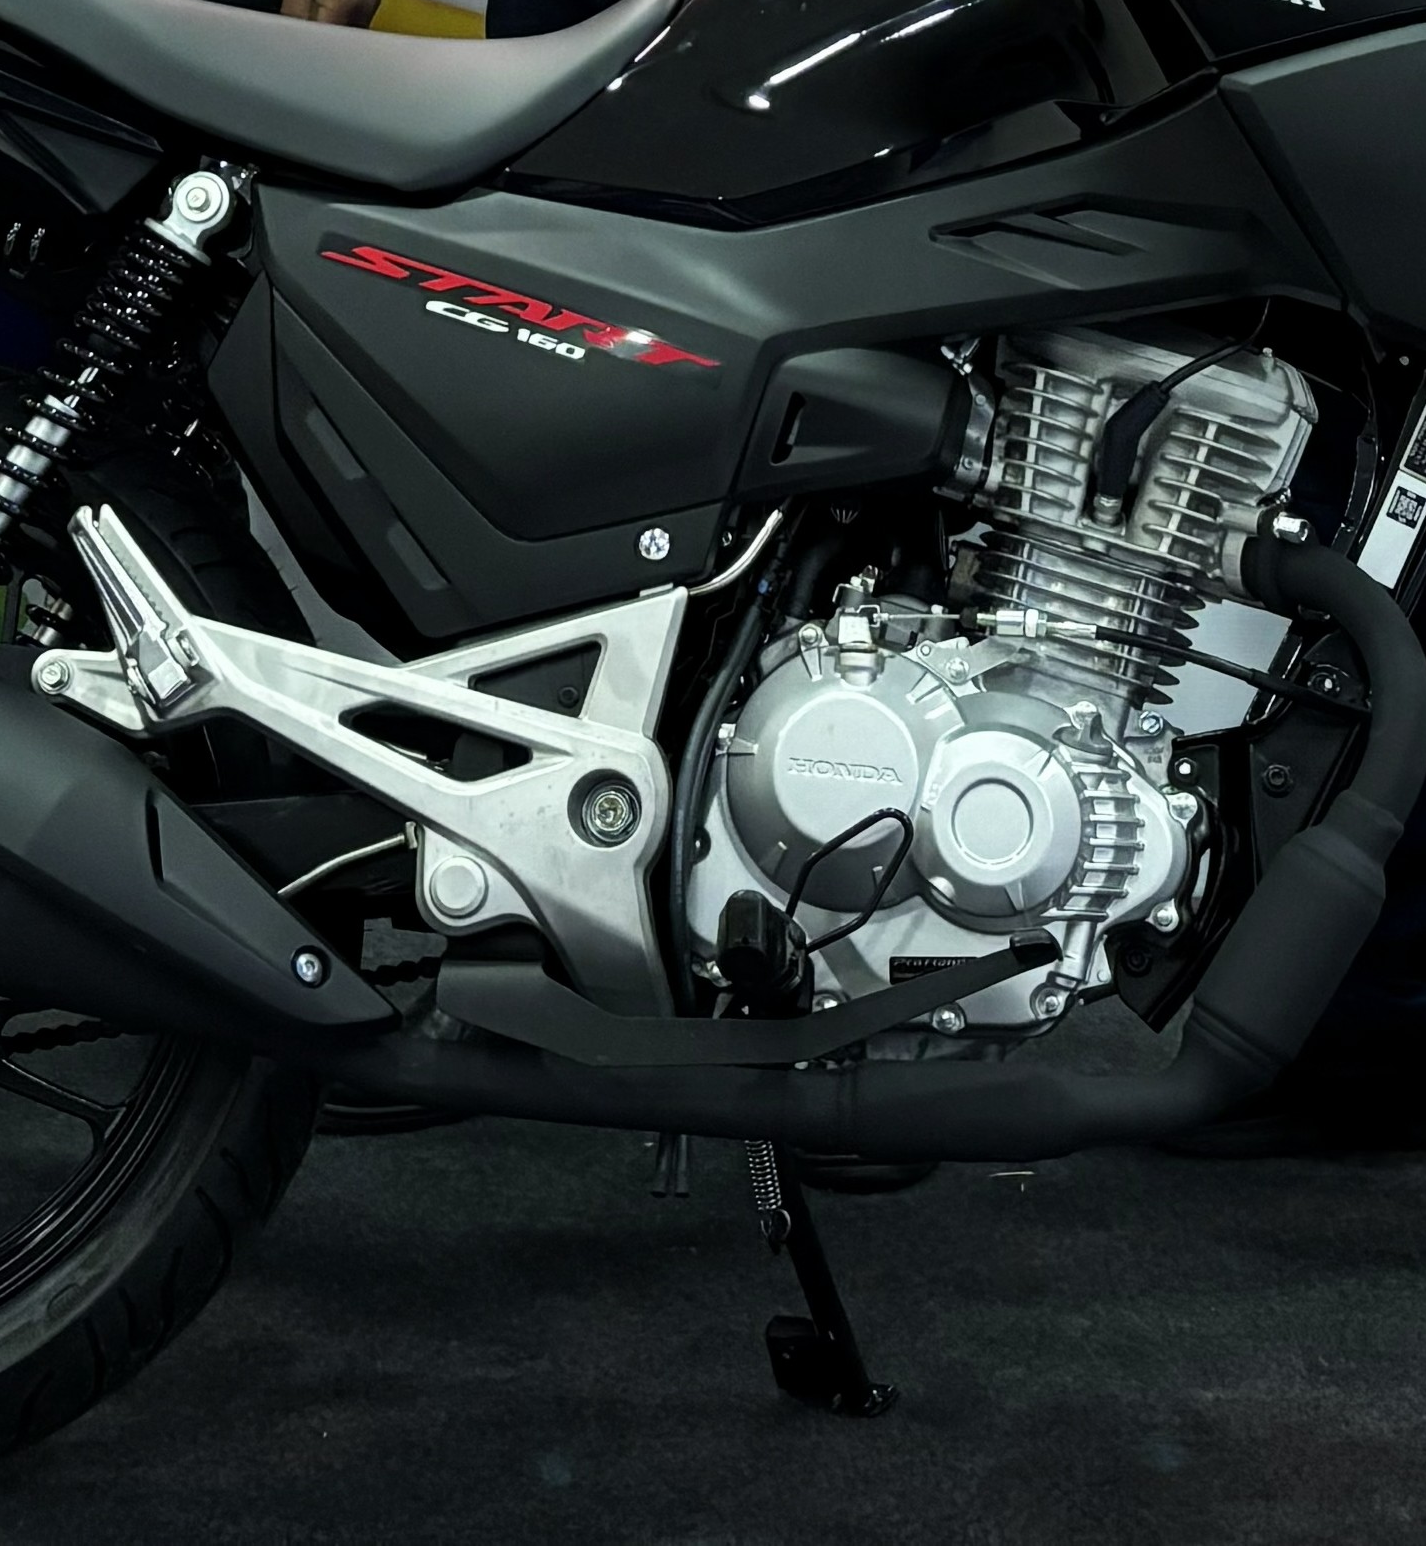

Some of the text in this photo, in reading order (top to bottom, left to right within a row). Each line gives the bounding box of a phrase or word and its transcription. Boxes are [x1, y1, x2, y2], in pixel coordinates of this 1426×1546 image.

[320, 246, 722, 368] START
[425, 300, 587, 362] CG 160
[787, 757, 904, 786] HONDA
